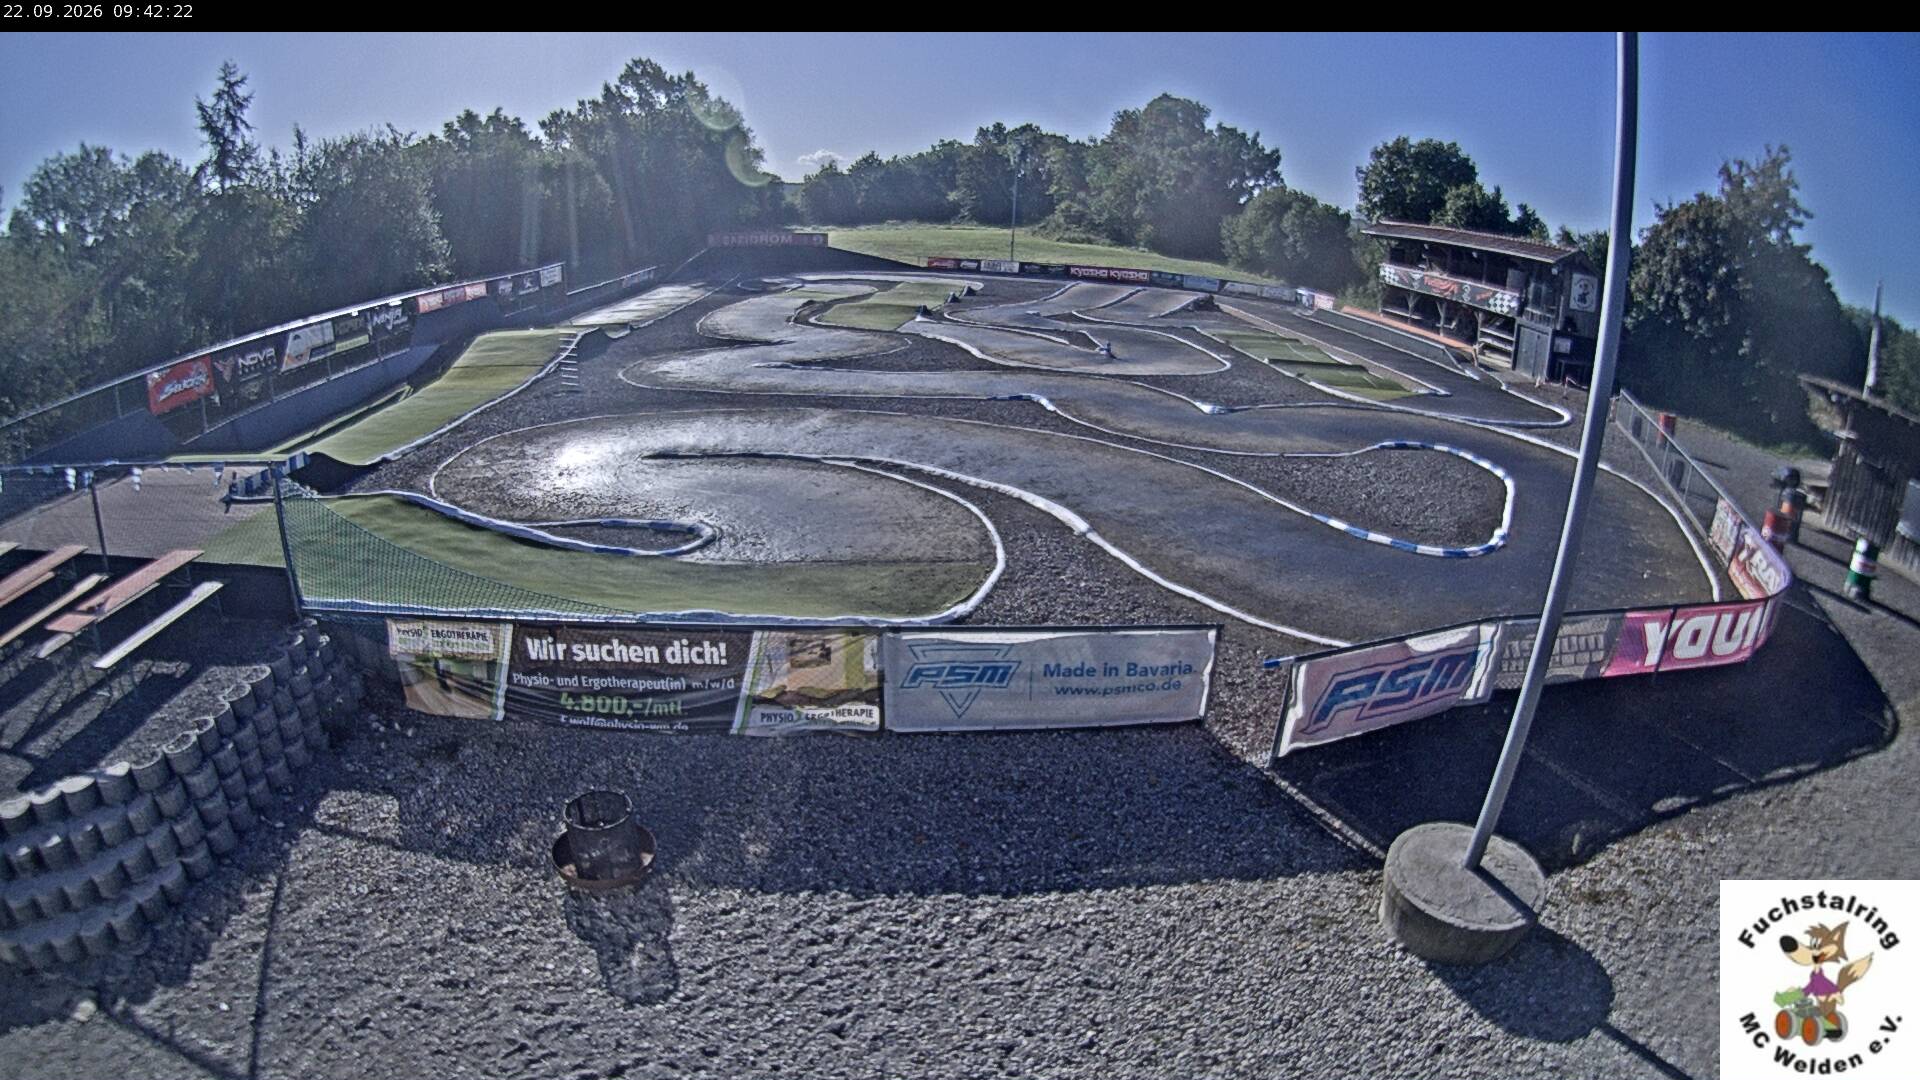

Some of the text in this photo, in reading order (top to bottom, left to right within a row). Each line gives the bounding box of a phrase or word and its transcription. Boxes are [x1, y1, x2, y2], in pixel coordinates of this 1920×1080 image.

[526, 636, 728, 666] Wir suchen dich!
[903, 661, 1020, 688] PSM
[1043, 662, 1097, 678] Made
[1103, 662, 1120, 678] in
[512, 672, 735, 692] Physio- und Ergotherapeut(in) m/w/d
[1054, 678, 1182, 697] www.psmco.de
[1308, 650, 1480, 730] PSM
[760, 711, 794, 723] PHYSIO
